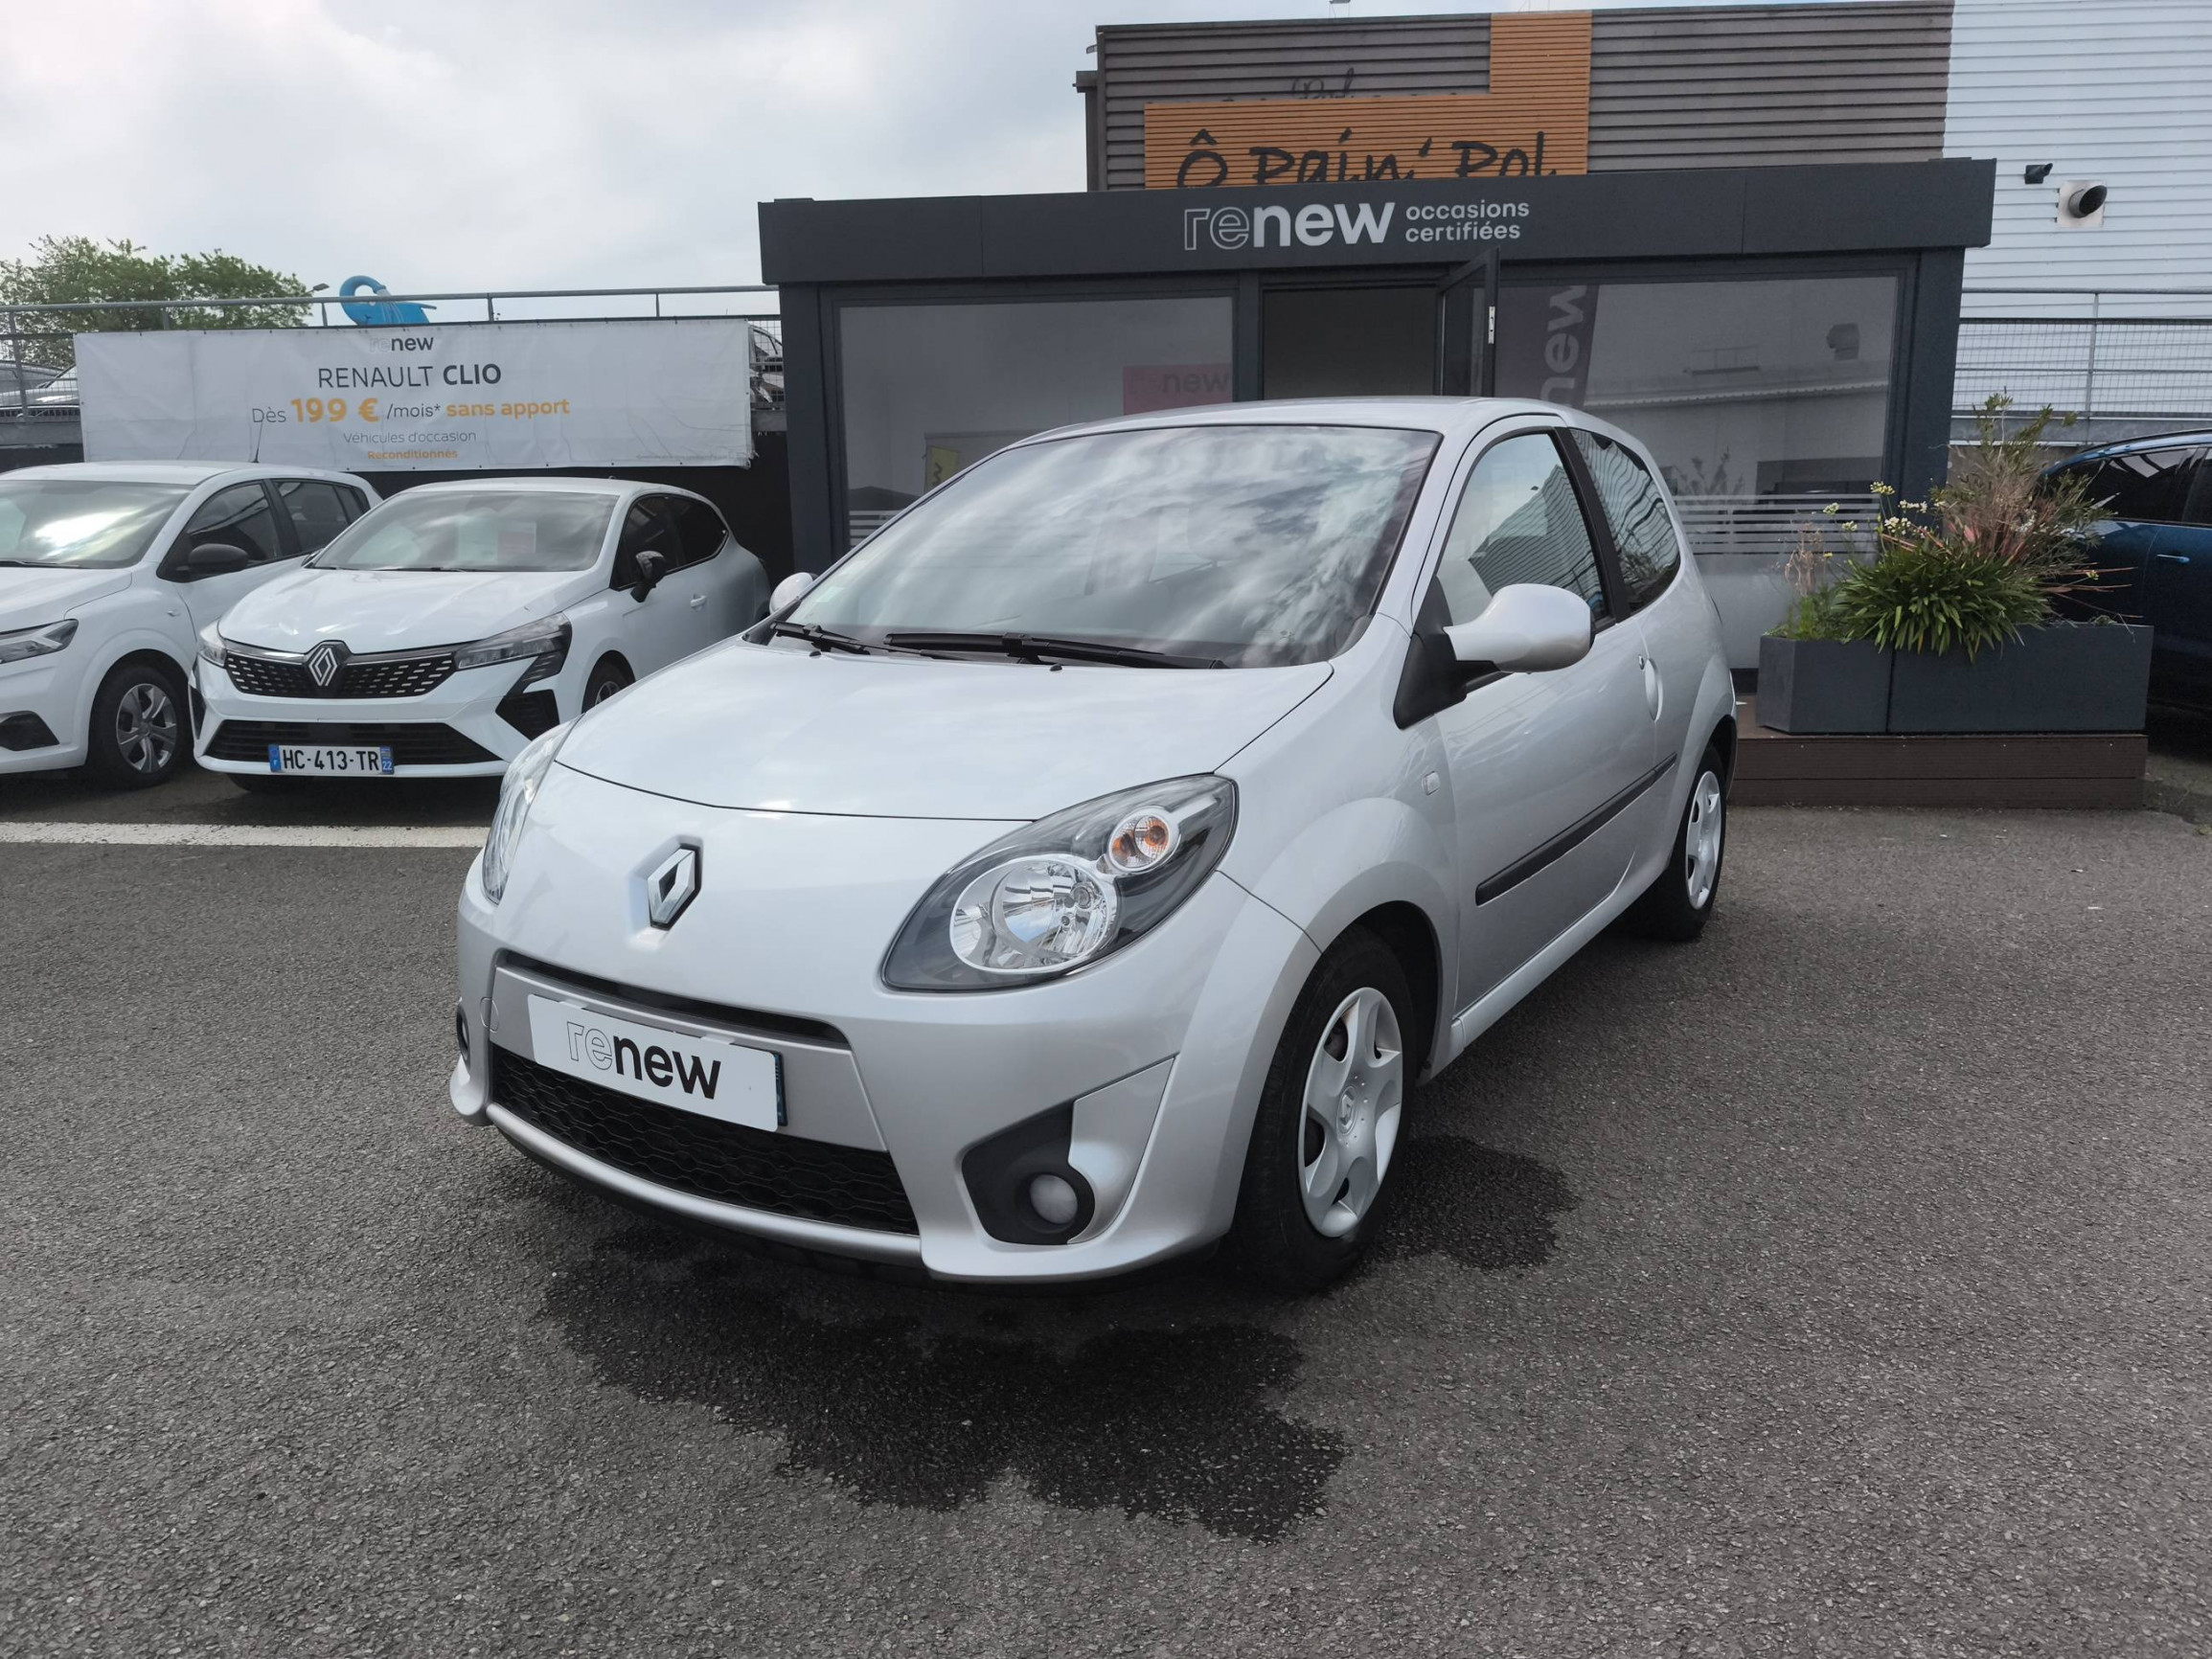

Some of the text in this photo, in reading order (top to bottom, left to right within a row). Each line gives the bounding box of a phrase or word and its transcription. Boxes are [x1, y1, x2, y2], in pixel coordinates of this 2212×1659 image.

[1177, 128, 1228, 188] Ô
[1405, 199, 1530, 220] occasions
[1184, 202, 1396, 250] renew
[1405, 221, 1521, 242] certifiées
[318, 363, 502, 388] RENAULT CLIO
[252, 406, 286, 423] Dès
[291, 398, 347, 423] 199
[358, 398, 380, 422] €
[446, 403, 495, 417] sans
[501, 398, 570, 420] apport
[343, 431, 477, 443] Véhicules d'occasion
[283, 749, 379, 770] HC-413-TR
[382, 761, 393, 770] 22
[566, 1021, 721, 1100] renew
